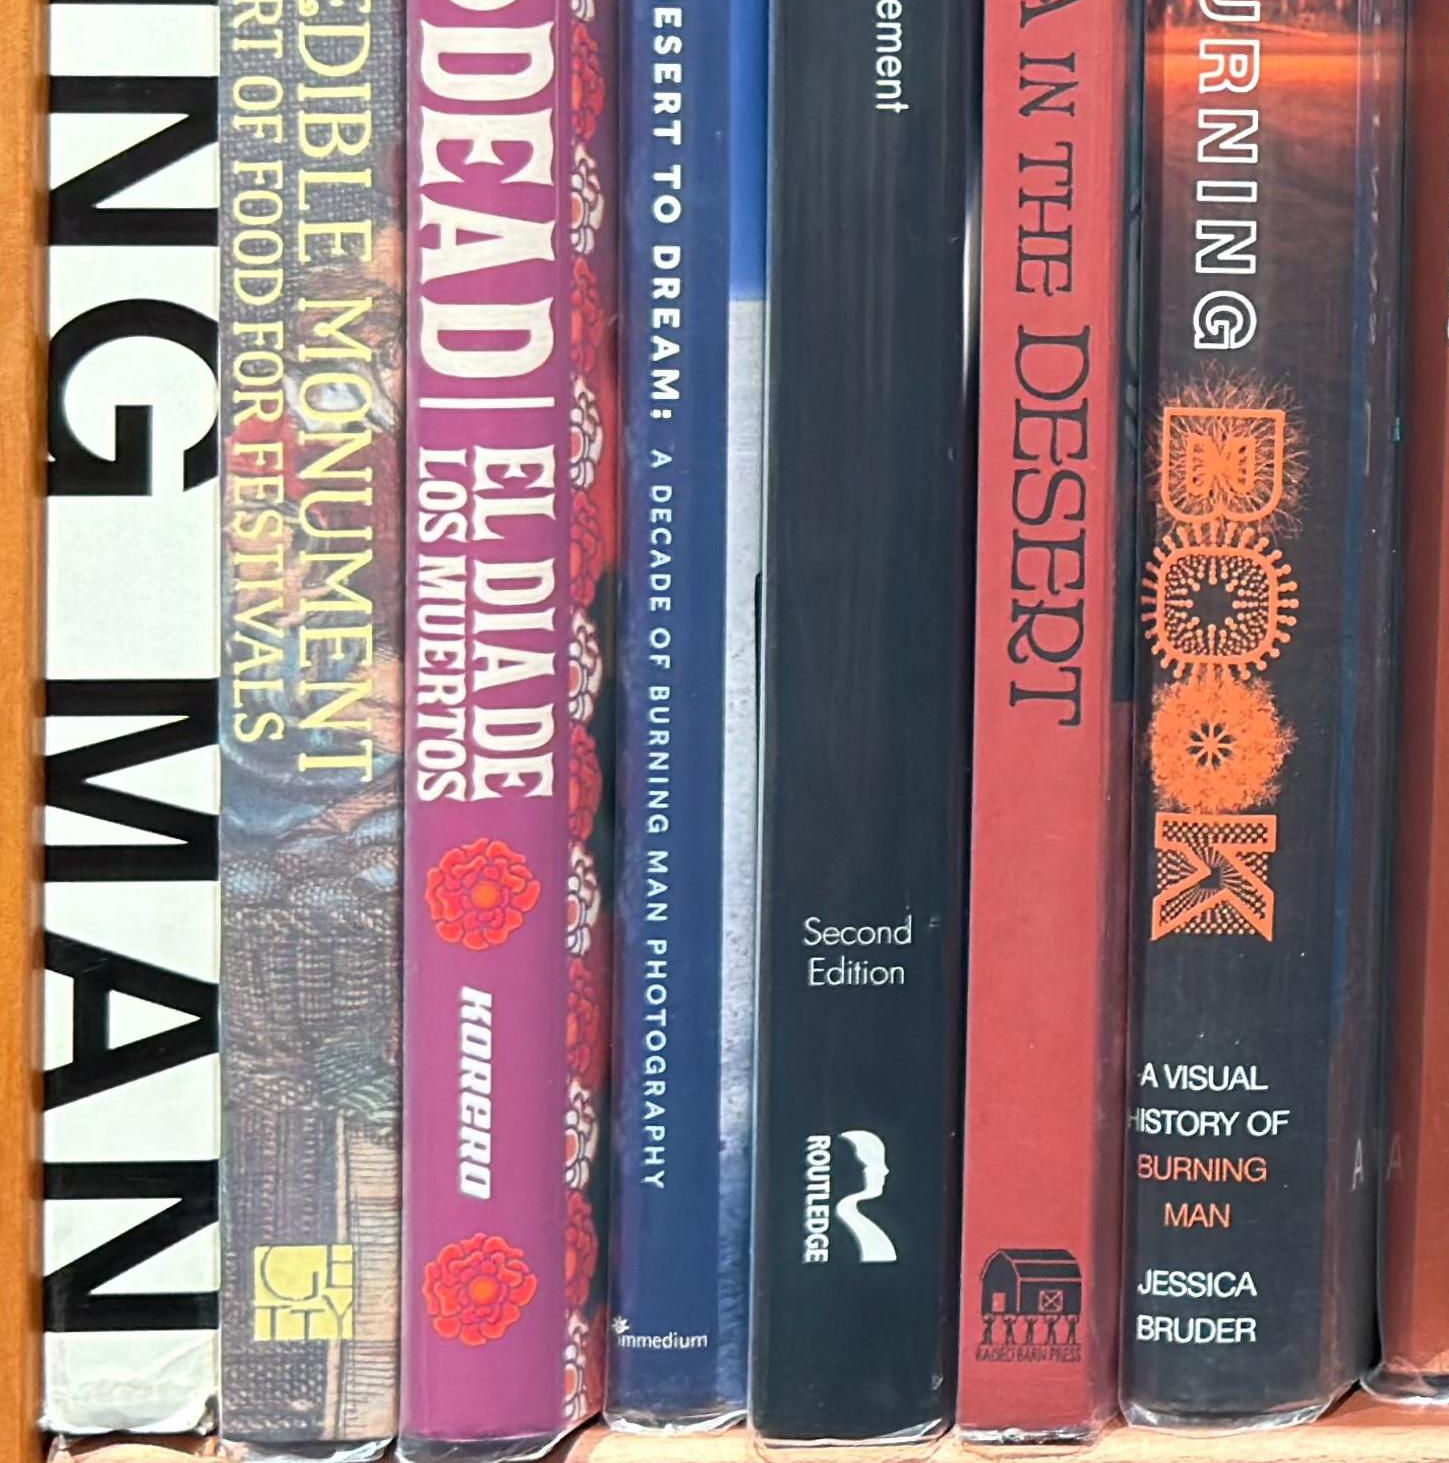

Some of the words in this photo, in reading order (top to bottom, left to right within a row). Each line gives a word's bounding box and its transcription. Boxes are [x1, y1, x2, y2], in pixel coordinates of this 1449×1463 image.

[232, 74, 284, 144] OF
[1018, 51, 1080, 118] IN
[232, 152, 284, 307] FOOD
[420, 21, 555, 380] DEAD
[652, 164, 683, 225] TO
[1015, 140, 1073, 297] THE
[232, 321, 284, 424] FOR
[650, 244, 683, 420] DREAM:
[418, 448, 468, 544] LOS
[472, 445, 556, 539] EL
[650, 449, 672, 468] A
[298, 297, 373, 781] MONUMENT
[649, 484, 672, 612] DECADE
[1007, 323, 1090, 728] DESERT
[232, 443, 284, 742] FESTIVALS
[472, 558, 556, 693] DIA
[416, 554, 468, 802] MUERTOS
[649, 627, 672, 669] OF
[472, 703, 556, 801] DE
[648, 686, 672, 834] BURNING
[647, 852, 670, 922] MAN
[803, 915, 913, 948] Second
[44, 679, 218, 1332] MAN
[808, 958, 905, 988] Edition
[641, 938, 670, 1190] PHOTOGRAPHY
[1140, 1062, 1159, 1087] A
[1163, 1063, 1269, 1091] VISUAL
[1137, 1153, 1268, 1182] BURNING
[1246, 1110, 1290, 1136] OF
[804, 1134, 831, 1264] ROUTLEDGE
[1164, 1202, 1231, 1228] MAN
[1136, 1315, 1257, 1344] BRUDER
[1137, 1268, 1258, 1298] JESSICA
